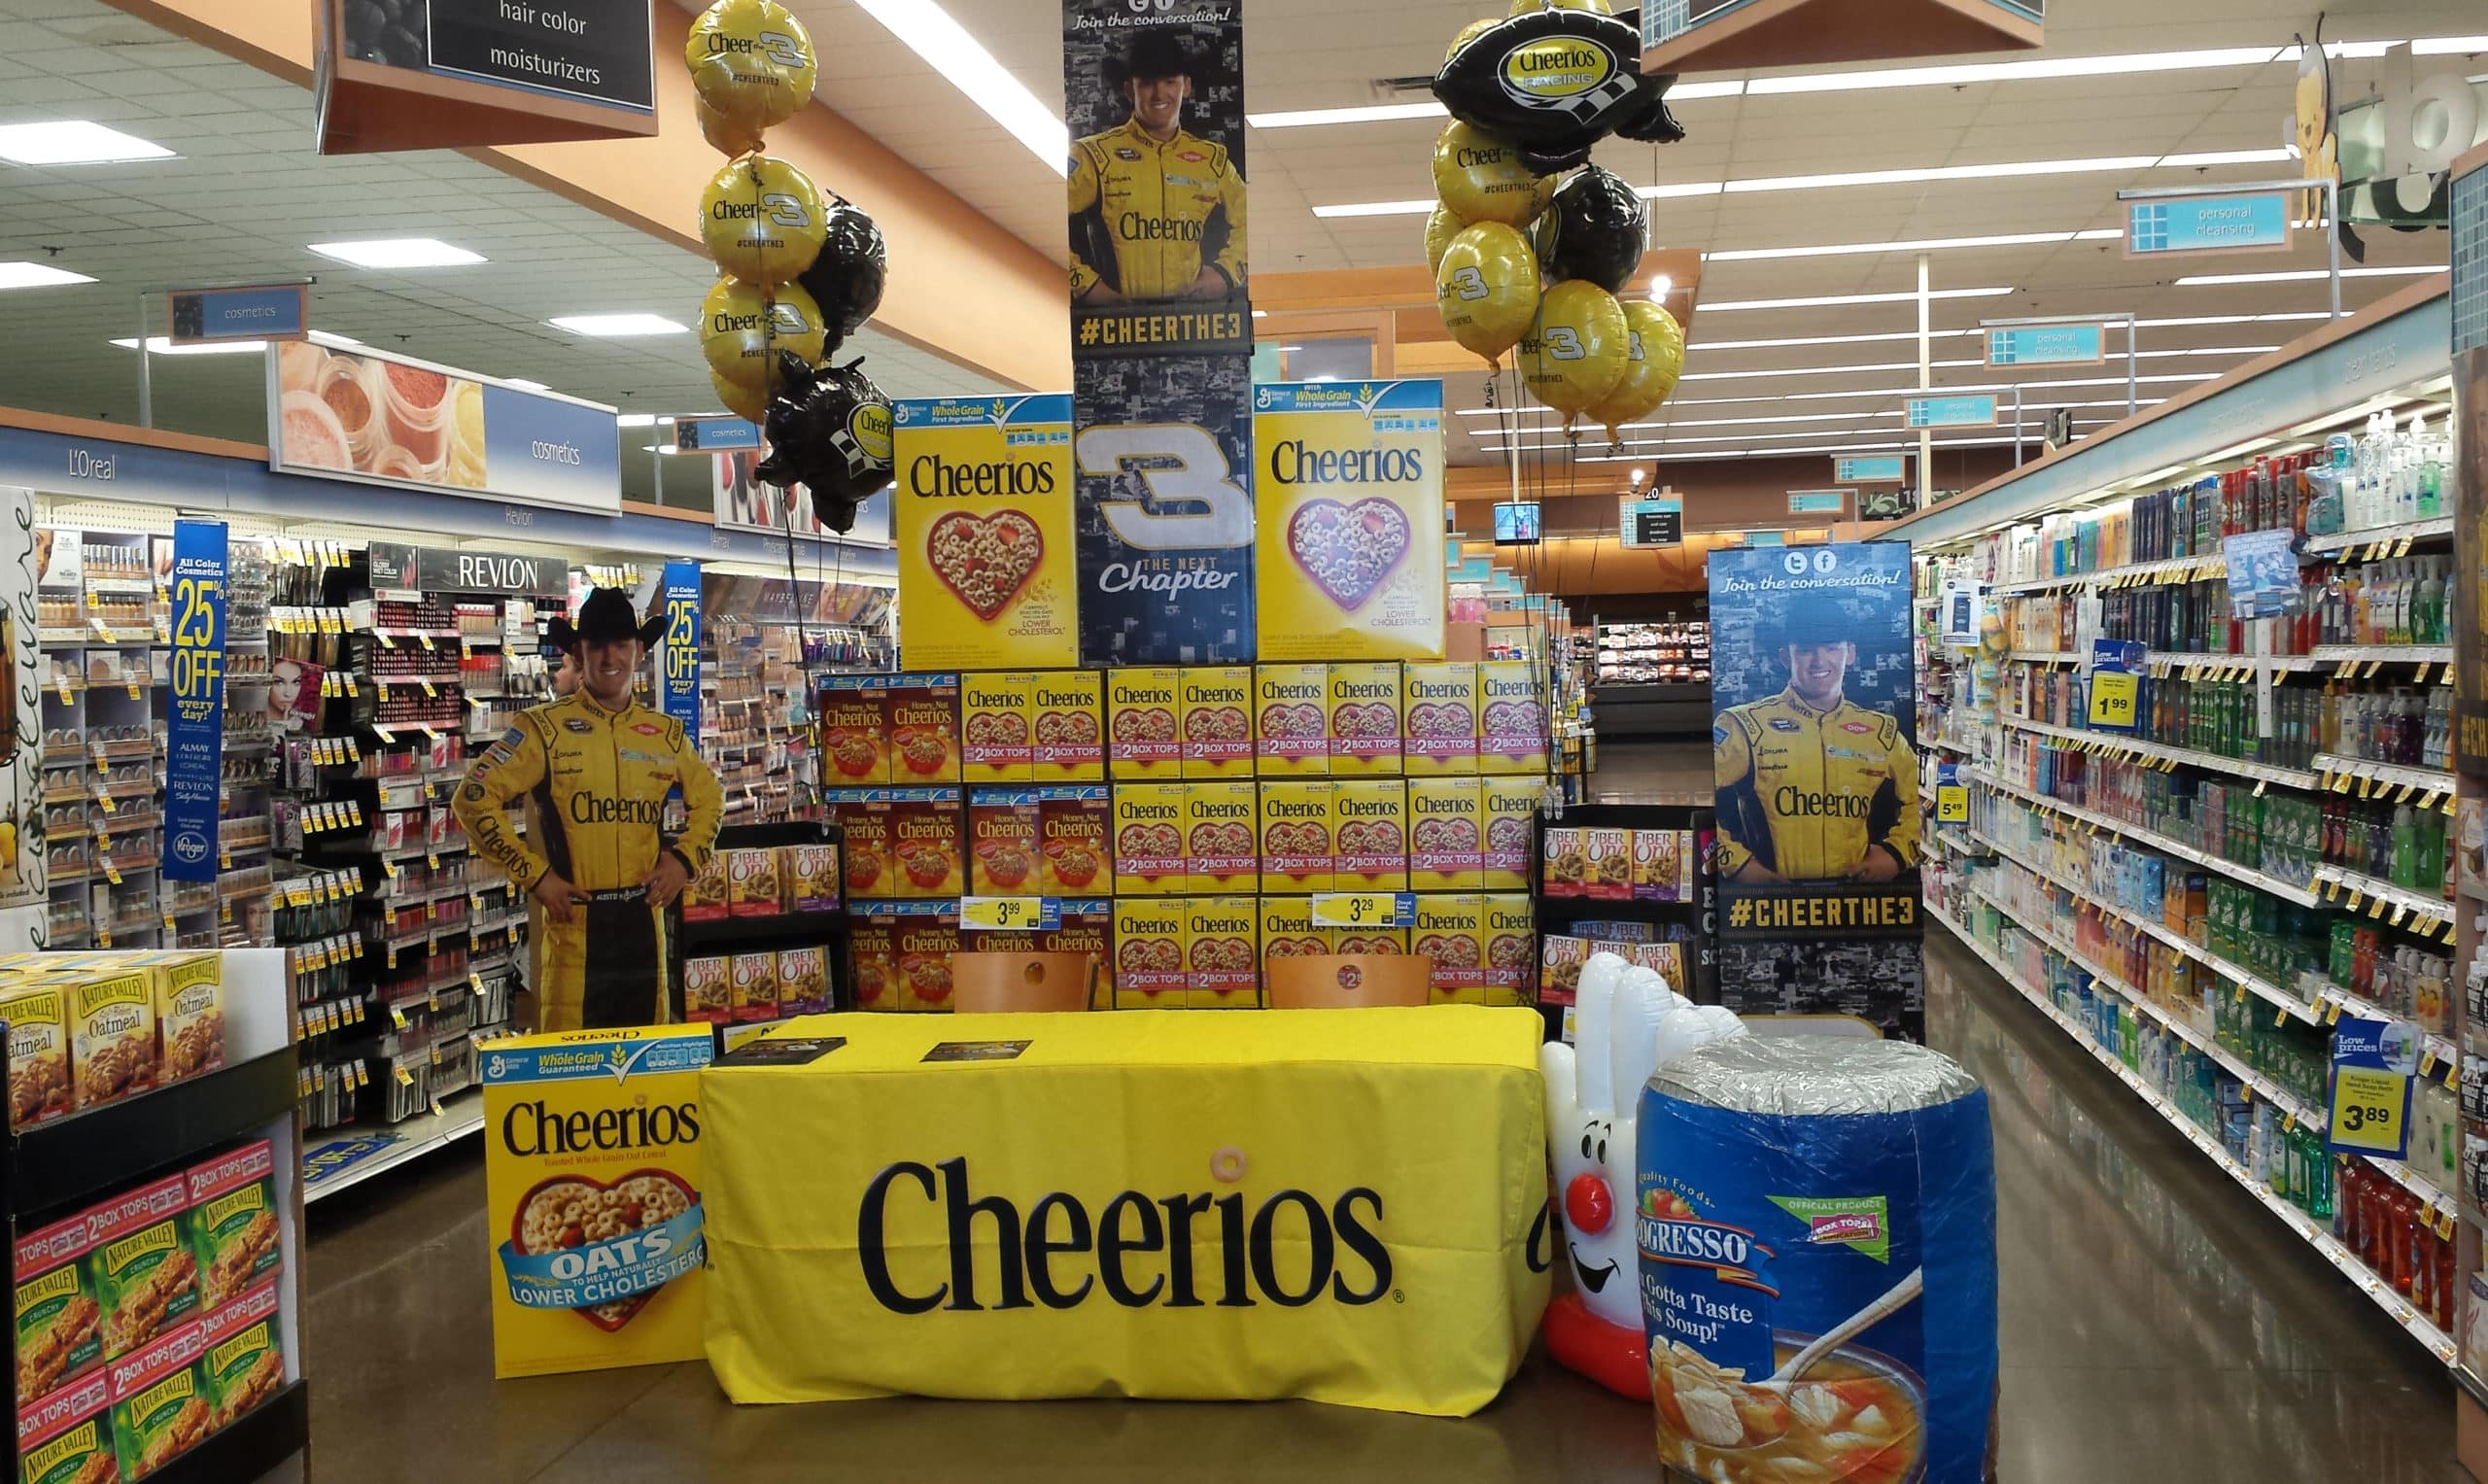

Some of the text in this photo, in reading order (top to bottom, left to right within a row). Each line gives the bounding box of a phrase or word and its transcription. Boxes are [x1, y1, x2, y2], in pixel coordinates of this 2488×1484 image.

[500, 0, 587, 35] hair color
[1073, 8, 1231, 30] Join the conversation!
[708, 31, 805, 68] Cheer 3
[490, 49, 601, 85] moisturizers
[1523, 73, 1593, 87] RACING
[1457, 147, 1503, 169] Cheer
[713, 193, 810, 226] Cheer 3
[2198, 205, 2252, 221] personal
[1120, 211, 1202, 242] Cheerios
[2196, 223, 2255, 237] cleansing
[1454, 265, 1490, 301] 3
[225, 305, 276, 320] cosmetics
[715, 313, 758, 333] Cheer
[1080, 313, 1240, 345] #CHEERTHE3
[1545, 326, 1586, 361] 3
[1296, 391, 1326, 401] Whole
[1327, 391, 1351, 401] Grain
[931, 406, 960, 416] Whole
[960, 405, 985, 415] Grain
[712, 430, 746, 438] cosmetics
[532, 438, 580, 466] cosmetics
[1271, 437, 1423, 484] Cheerios
[68, 448, 116, 480] L'Oreal
[910, 452, 1054, 499] Cheerios
[1076, 423, 1255, 551] 3
[176, 567, 225, 577] Cosmetics
[180, 558, 222, 569] All Color
[459, 555, 538, 590] REVLON
[1142, 557, 1217, 571] THE NEXT
[1099, 561, 1238, 602] Chapter
[1720, 569, 1900, 594] Join the conversation!
[1022, 620, 1051, 629] LOWER
[173, 648, 222, 698] OFF
[667, 646, 698, 678] OFF
[177, 701, 215, 712] every
[181, 709, 209, 723] day!
[975, 747, 1031, 761] 2 BOX TOPS
[1122, 743, 1180, 758] 2 BOX TOPS
[1269, 739, 1328, 754] 2 BOX TOPS
[1341, 738, 1400, 753] 2 BOX TOPS
[1416, 739, 1475, 754] 2 BOX TOPS
[173, 780, 214, 791] REVLON
[570, 790, 660, 825] Cheerios
[1775, 785, 1870, 818] Cheerios
[177, 836, 205, 859] Kroger
[476, 814, 532, 880] Cheerios
[1545, 831, 1580, 844] FIBER
[730, 851, 769, 864] FIBER
[796, 847, 835, 860] FIBER
[732, 862, 776, 881] One
[798, 857, 837, 878] One
[1729, 896, 1914, 927] #CHEERTHE3
[684, 959, 722, 972] FIBER
[733, 955, 771, 968] FIBER
[779, 949, 818, 964] FIBER
[686, 970, 728, 989] One
[735, 966, 777, 985] One
[781, 961, 822, 982] One
[82, 980, 144, 1011] NATURE VALLEY
[174, 990, 214, 1018] Oatmeal
[88, 1010, 141, 1039] Oatmeal
[9, 1030, 52, 1059] atmeal
[2338, 1035, 2366, 1045] Low
[2338, 1044, 2378, 1053] prices
[538, 1052, 605, 1067] Whole Grain
[538, 1063, 599, 1075] Guaranteed
[502, 1096, 701, 1157] Cheerios
[544, 1150, 667, 1166] Toasted Whole Grain Oat Cereal
[1673, 1178, 1710, 1207] Foods
[208, 1187, 261, 1230] NATURE VALLEY
[1788, 1200, 1881, 1210] OFFICIAL PRODUCT
[87, 1196, 149, 1242] 2 BOX TOPS
[858, 1148, 1393, 1315] Cheerios
[108, 1223, 175, 1266] NATURE VALLEY
[550, 1227, 673, 1280] OATS
[129, 1255, 159, 1275] CRUNCHY
[573, 1258, 661, 1287] TO HELP NATURALLY
[43, 1268, 76, 1294] VALLEY
[512, 1286, 577, 1305] LOWER
[1646, 1274, 1753, 1324] Gotta Taste
[29, 1302, 60, 1323] CRUNCHY
[1666, 1307, 1718, 1345] Soup!
[144, 1349, 169, 1371] TOPS
[213, 1329, 267, 1373] NATURE VALLEY
[132, 1373, 190, 1423] NATURE VALLEY
[152, 1405, 179, 1426] CRUNCHY
[26, 1428, 94, 1478] NATURE VALLEY
